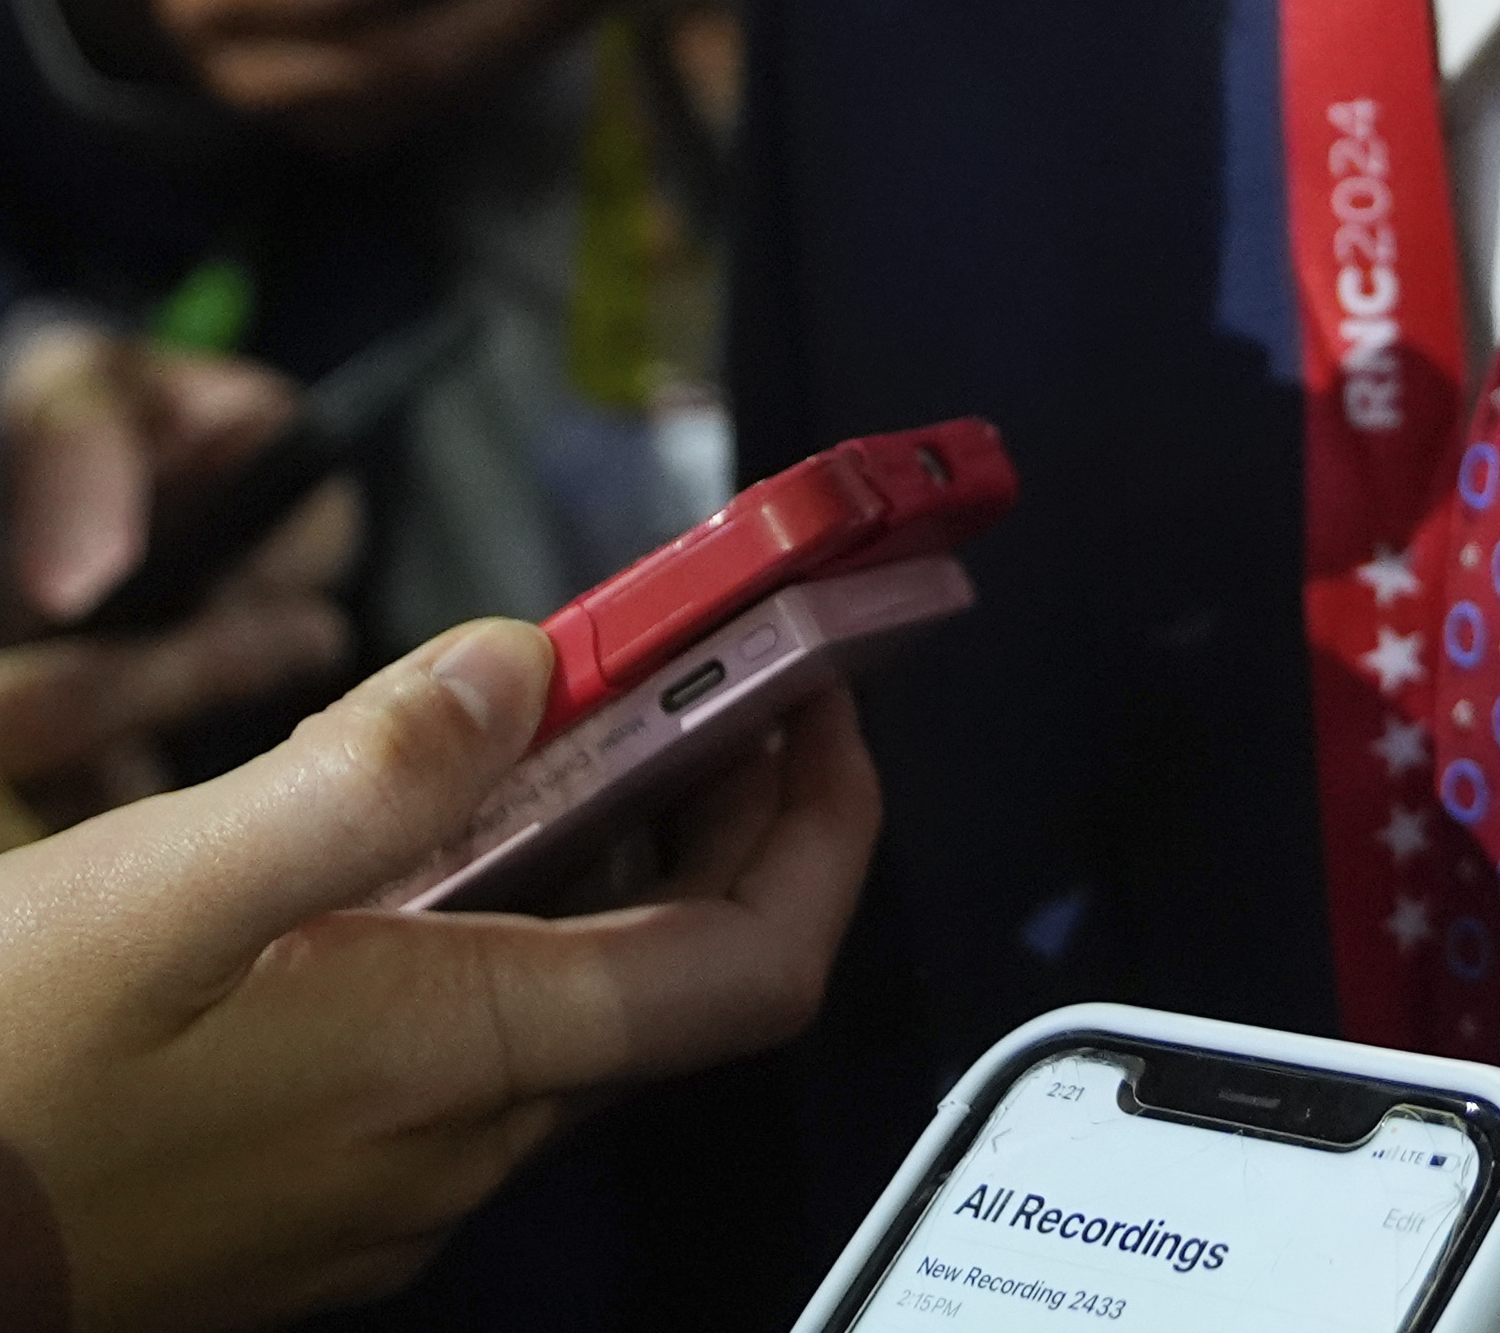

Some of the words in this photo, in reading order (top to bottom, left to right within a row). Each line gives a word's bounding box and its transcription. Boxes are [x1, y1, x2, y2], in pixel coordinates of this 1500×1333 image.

[1326, 97, 1404, 429] RNC2024
[1046, 1081, 1086, 1102] 2:21
[1399, 1148, 1425, 1165] LTE
[953, 1183, 1016, 1224] All
[1008, 1192, 1230, 1273] Recordings
[916, 1255, 964, 1282] New
[963, 1266, 1067, 1310] Recording
[1067, 1289, 1128, 1320] 2433
